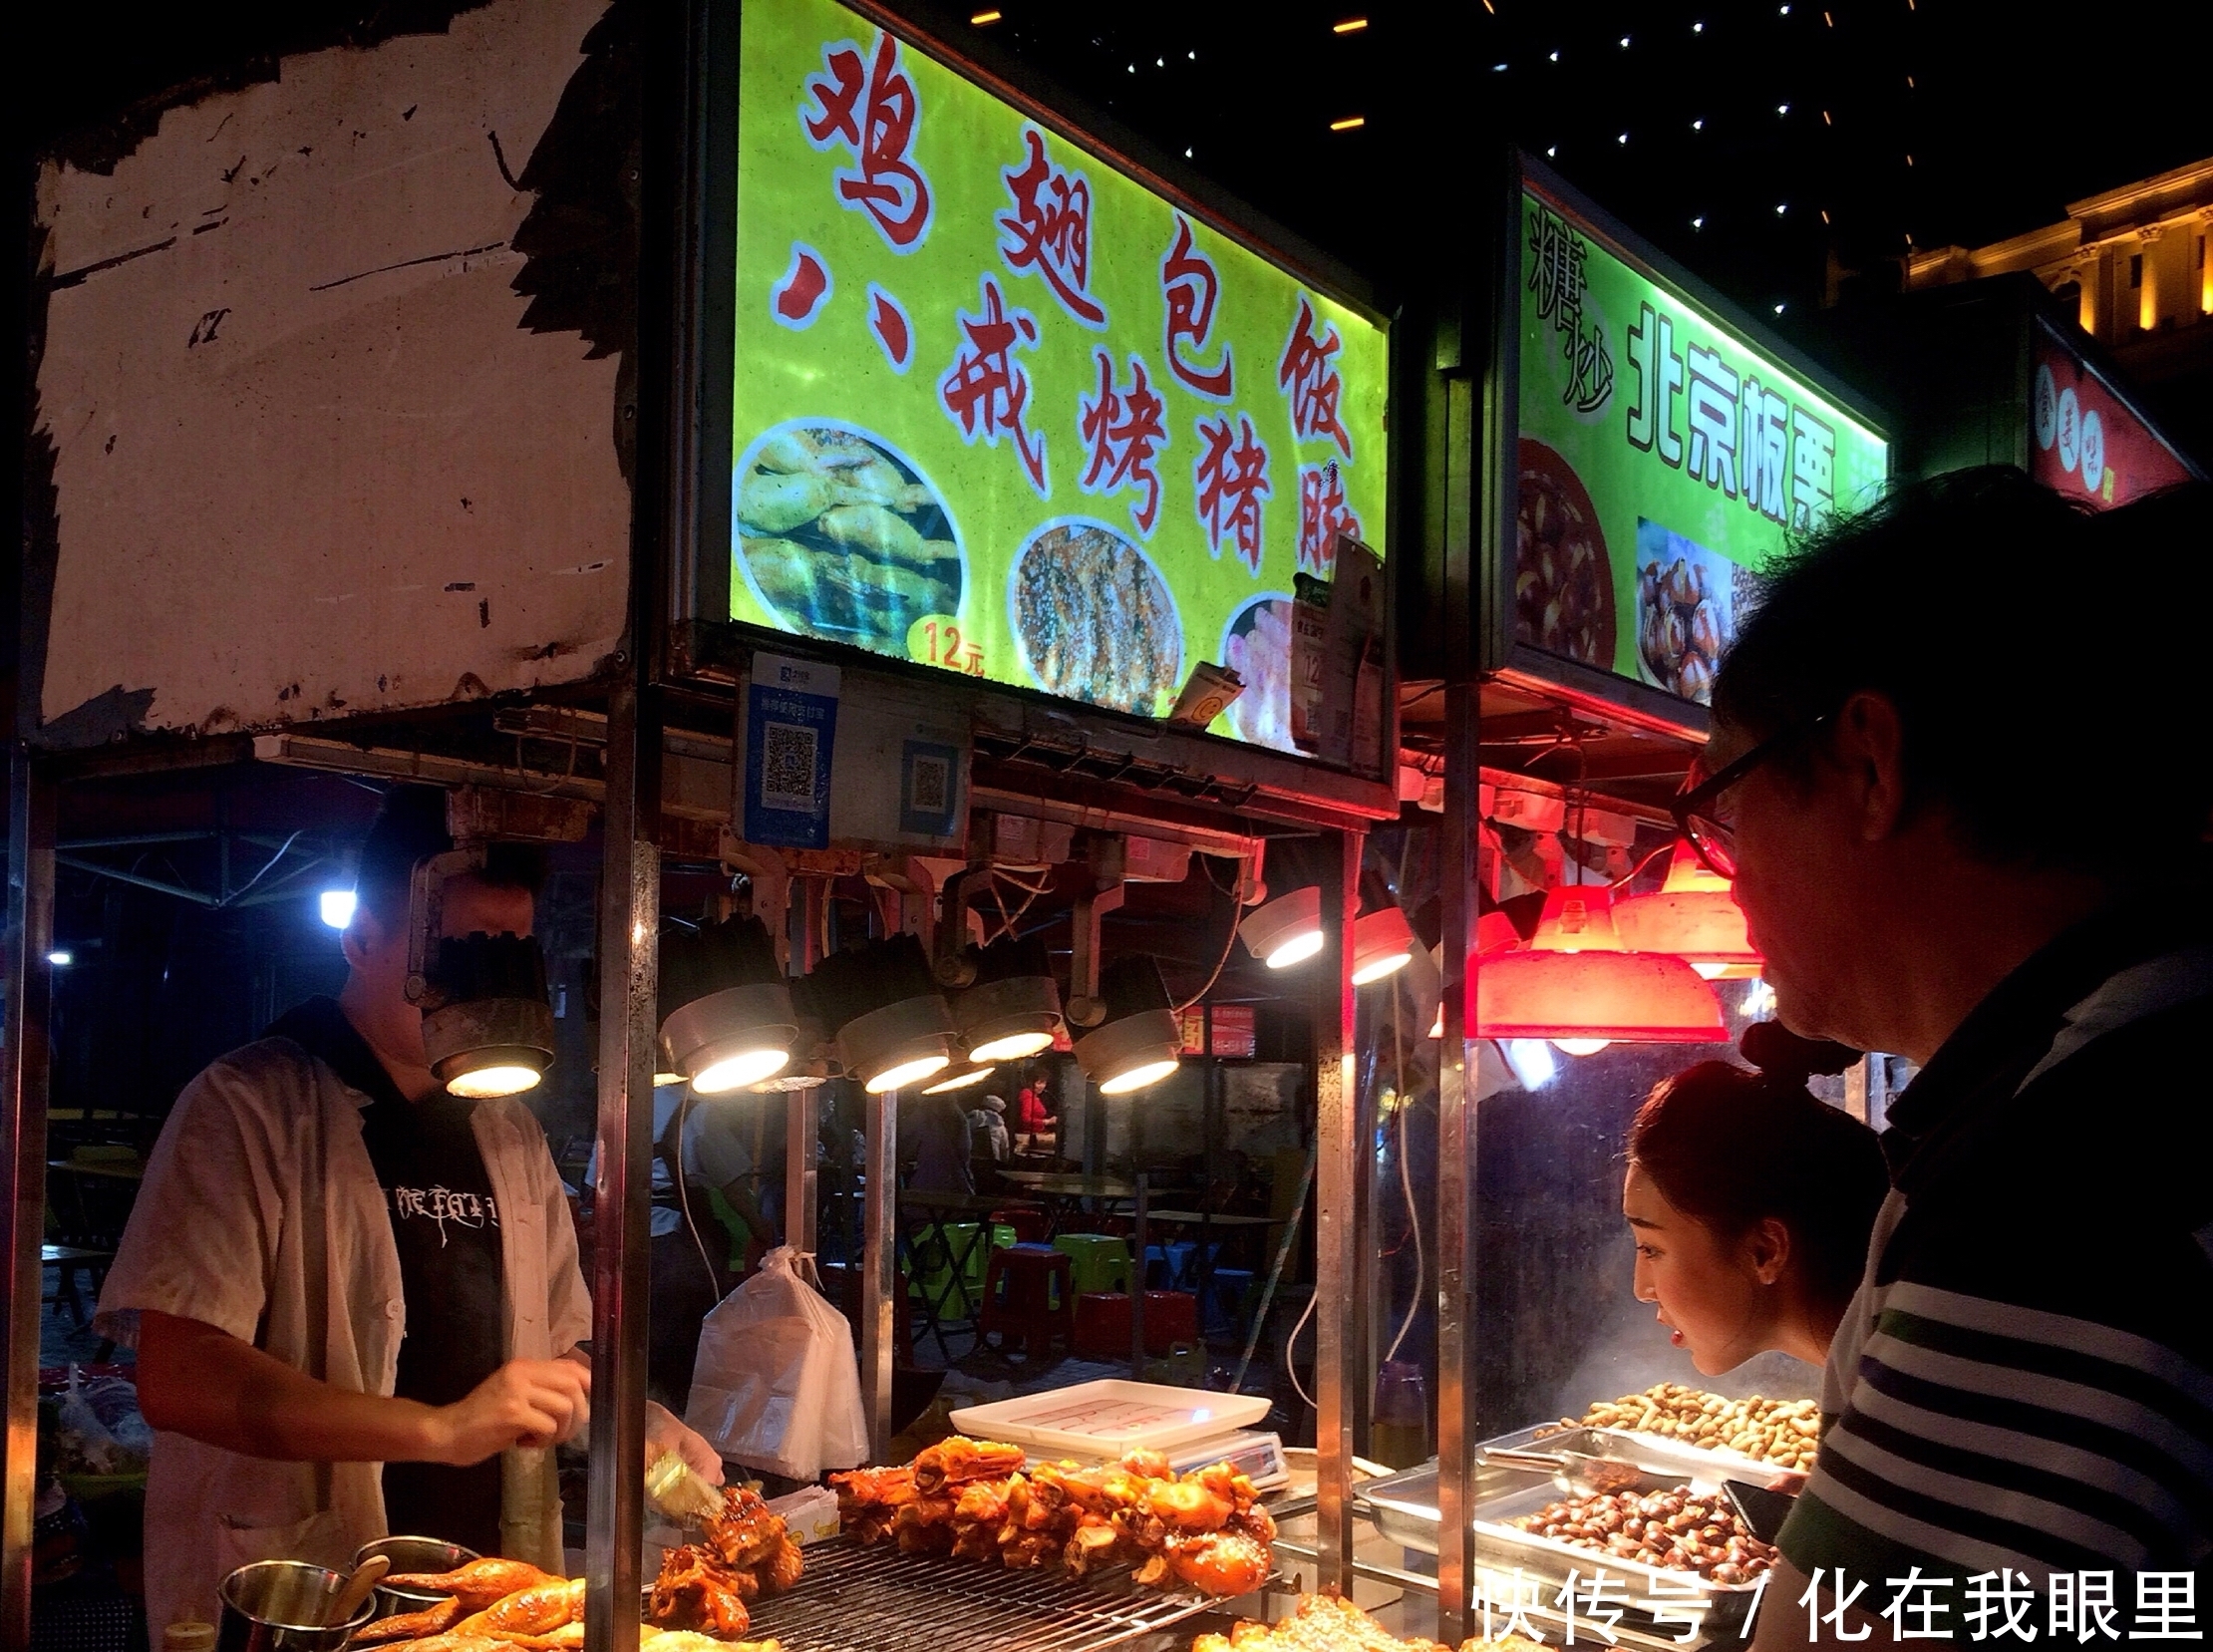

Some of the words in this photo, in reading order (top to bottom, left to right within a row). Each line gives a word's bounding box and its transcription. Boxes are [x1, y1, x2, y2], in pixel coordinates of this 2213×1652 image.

[803, 30, 1350, 459] 鸡翅包饭
[1528, 203, 1613, 412] 糖炒
[1627, 301, 1835, 535] 北京板栗
[924, 621, 985, 679] 12元
